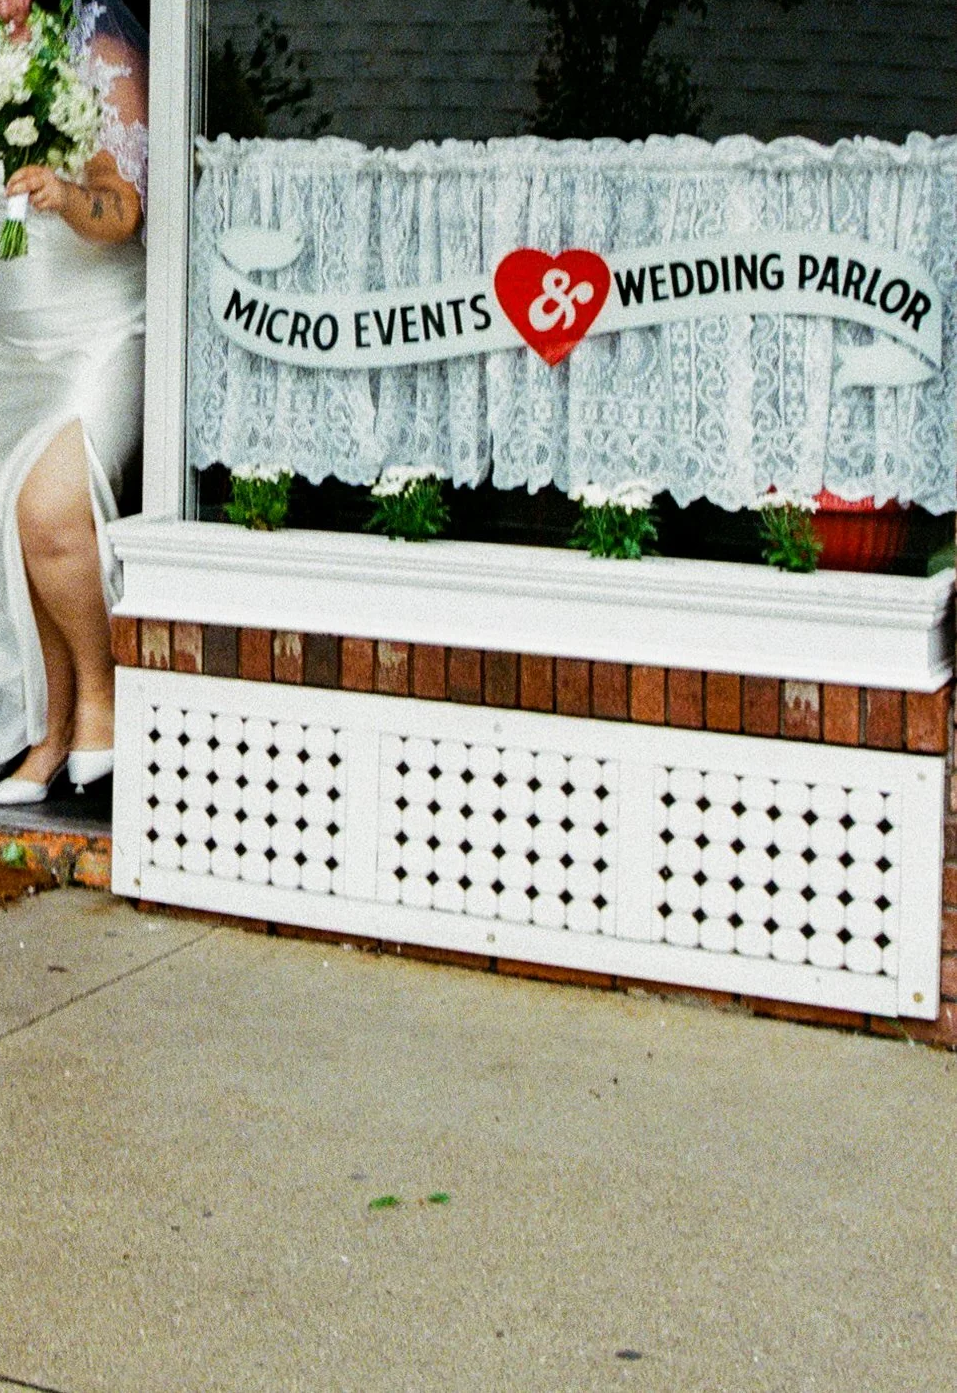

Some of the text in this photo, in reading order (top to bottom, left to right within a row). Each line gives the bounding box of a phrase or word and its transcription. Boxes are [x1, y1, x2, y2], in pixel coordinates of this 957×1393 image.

[223, 252, 932, 352] MICRO EVENTS & WEDDING PARLOR
